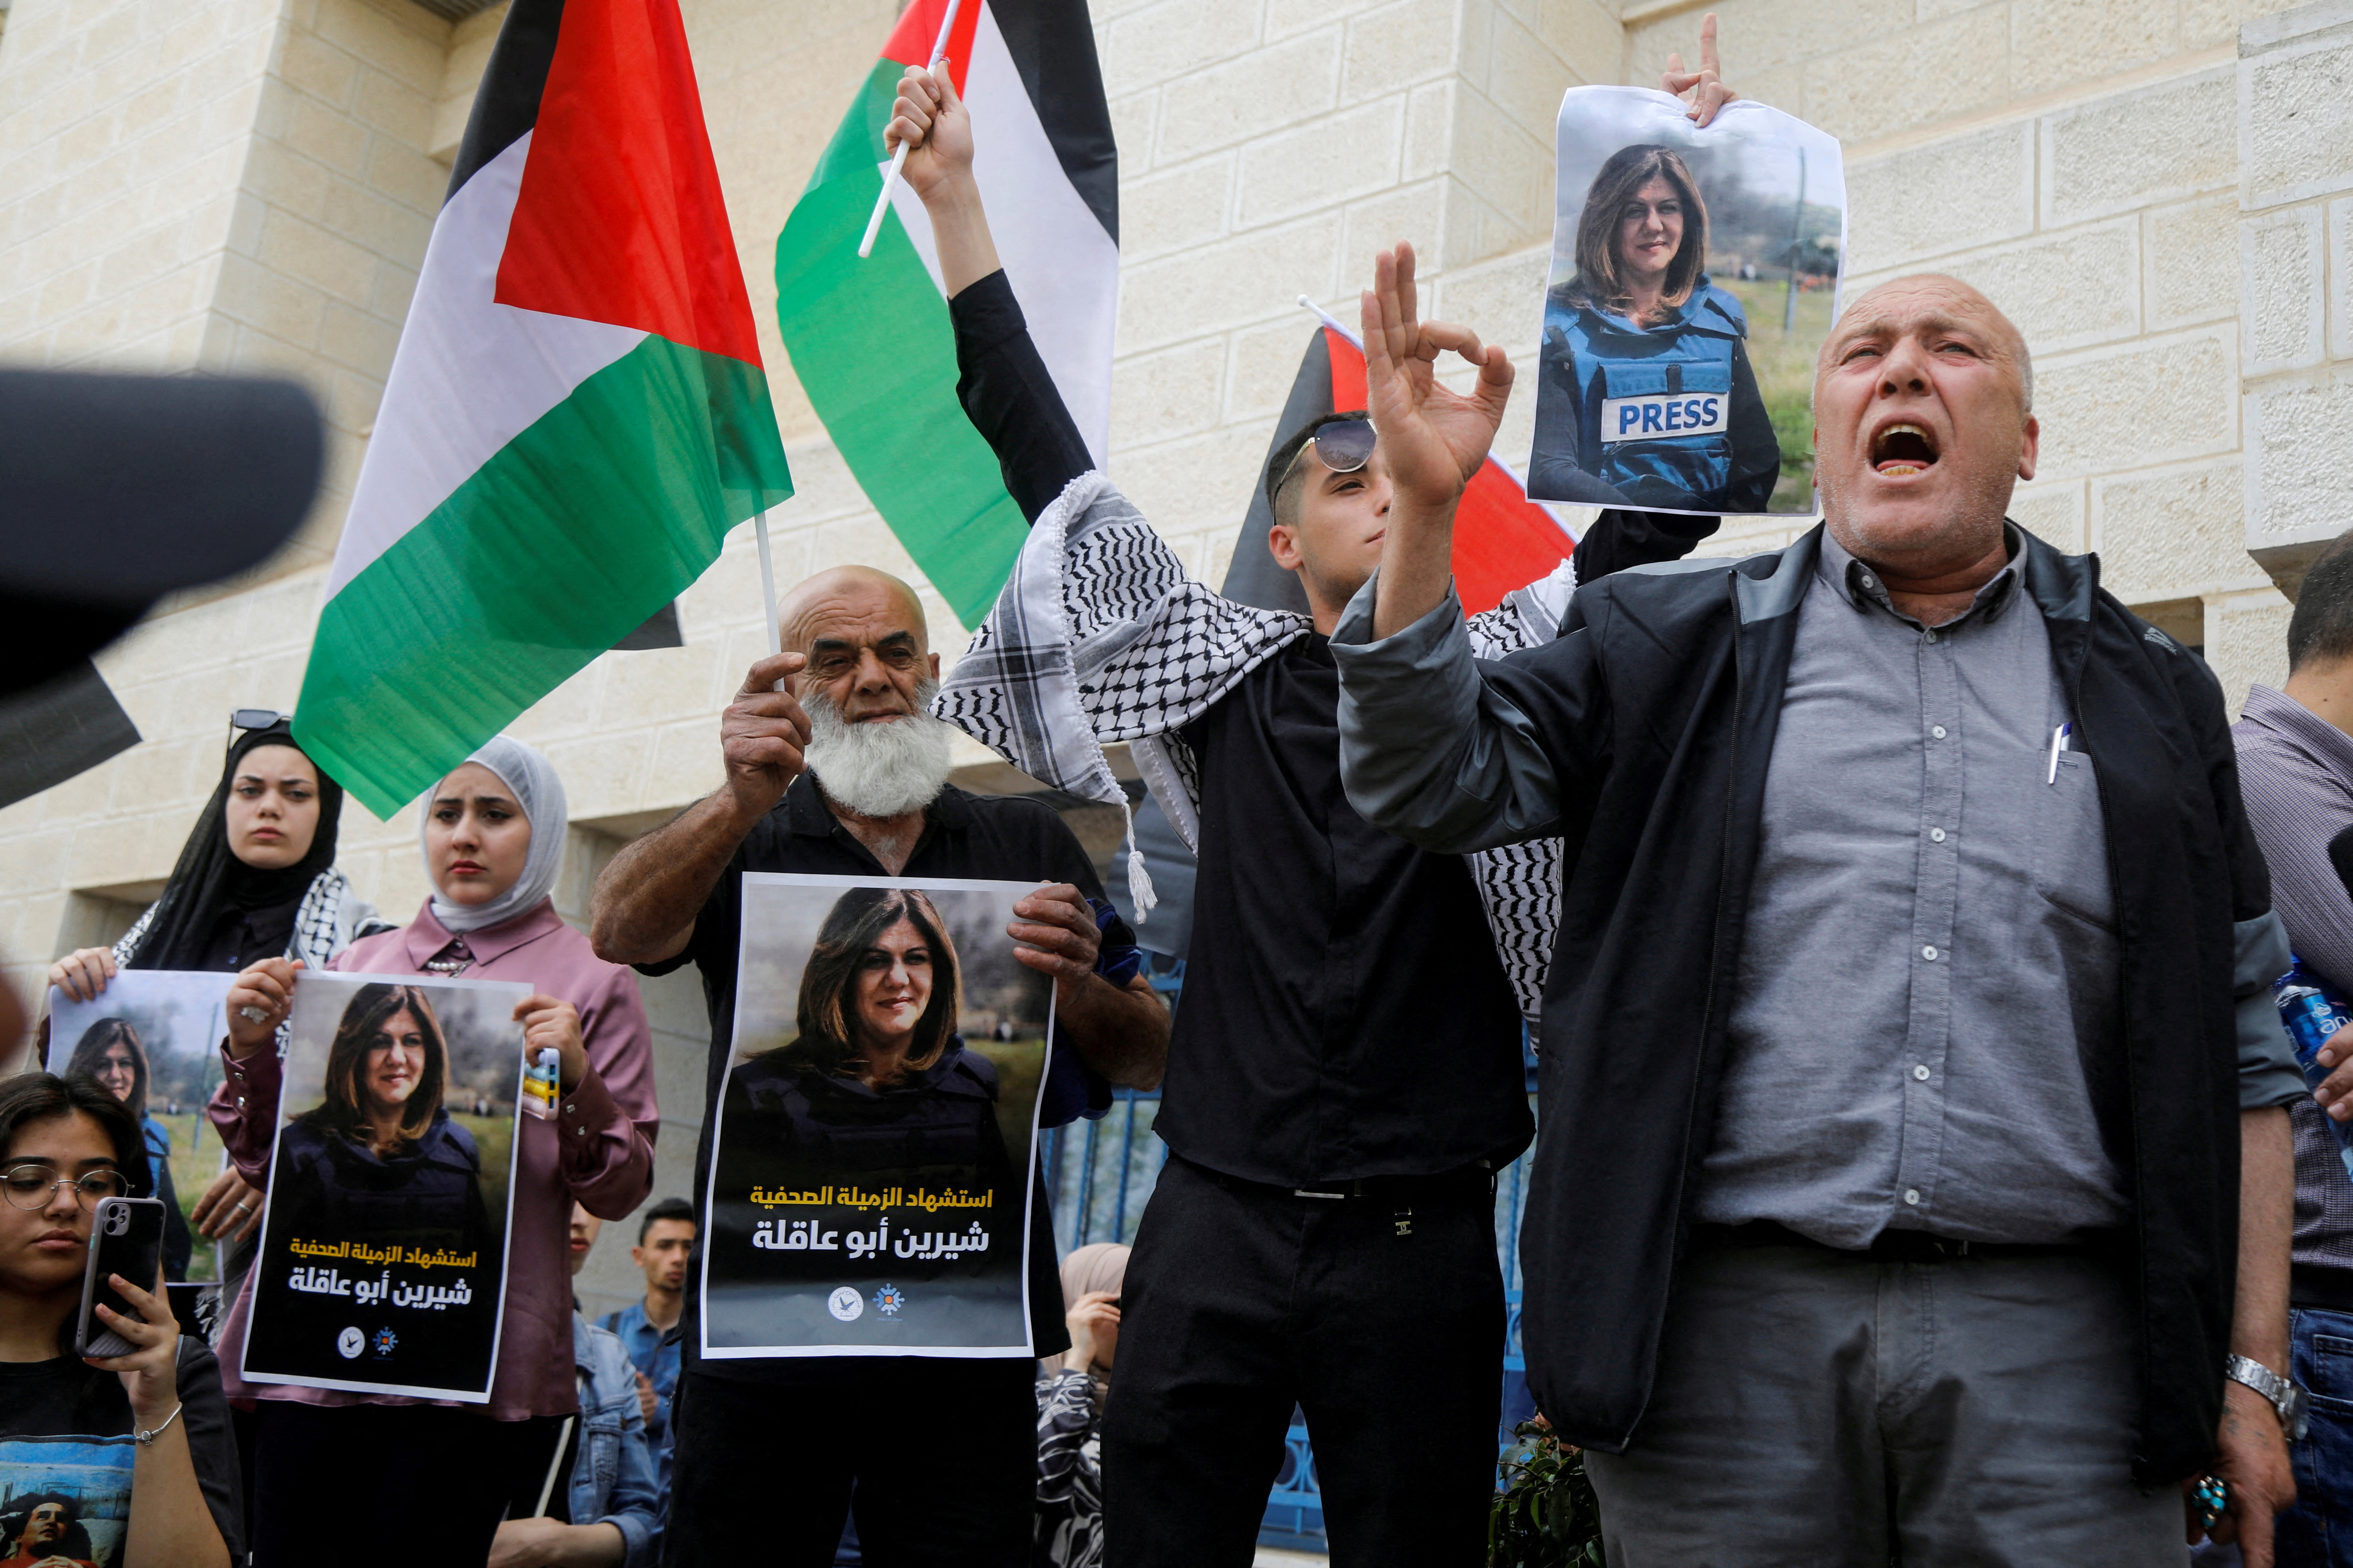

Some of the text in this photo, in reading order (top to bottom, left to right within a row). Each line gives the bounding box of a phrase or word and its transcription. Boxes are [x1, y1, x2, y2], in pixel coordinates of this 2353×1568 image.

[1619, 398, 1718, 435] PRESS
[750, 1186, 993, 1213] استشهاد الزميلة الصحفية
[290, 1238, 477, 1269] استشهاد الزميلة الصحفية
[752, 1216, 990, 1260] شيرين أبو عاقلة
[288, 1266, 473, 1311] شيرين أبو عاقلة
